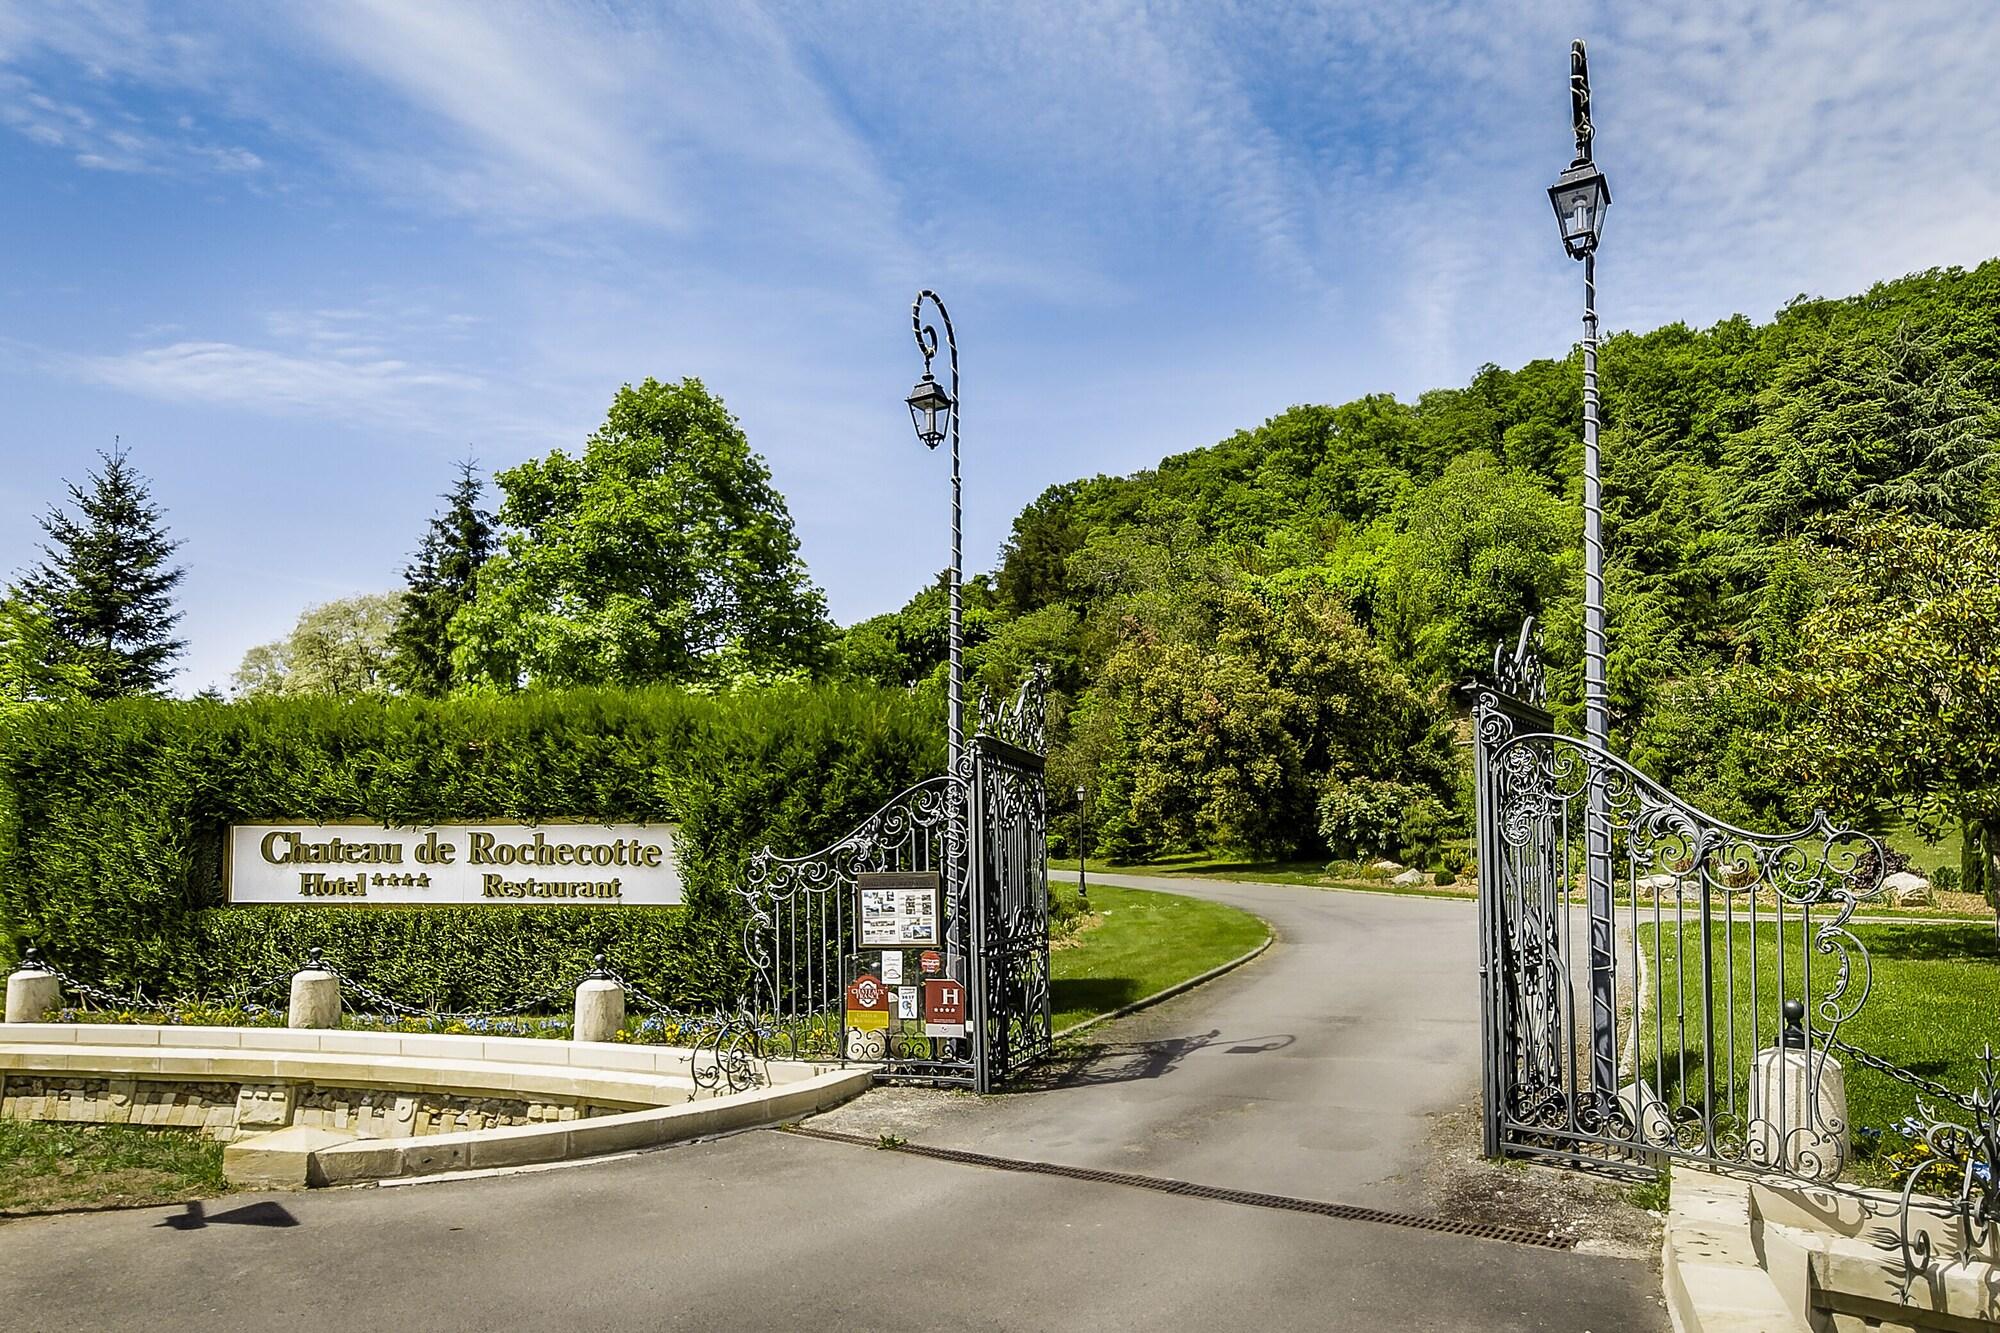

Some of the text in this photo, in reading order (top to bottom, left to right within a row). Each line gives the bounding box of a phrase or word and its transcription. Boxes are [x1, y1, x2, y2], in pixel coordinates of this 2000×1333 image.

[260, 831, 664, 867] Chateau de Rochecotte
[298, 872, 623, 898] Hotel Restaurant
[942, 988, 960, 1005] H
